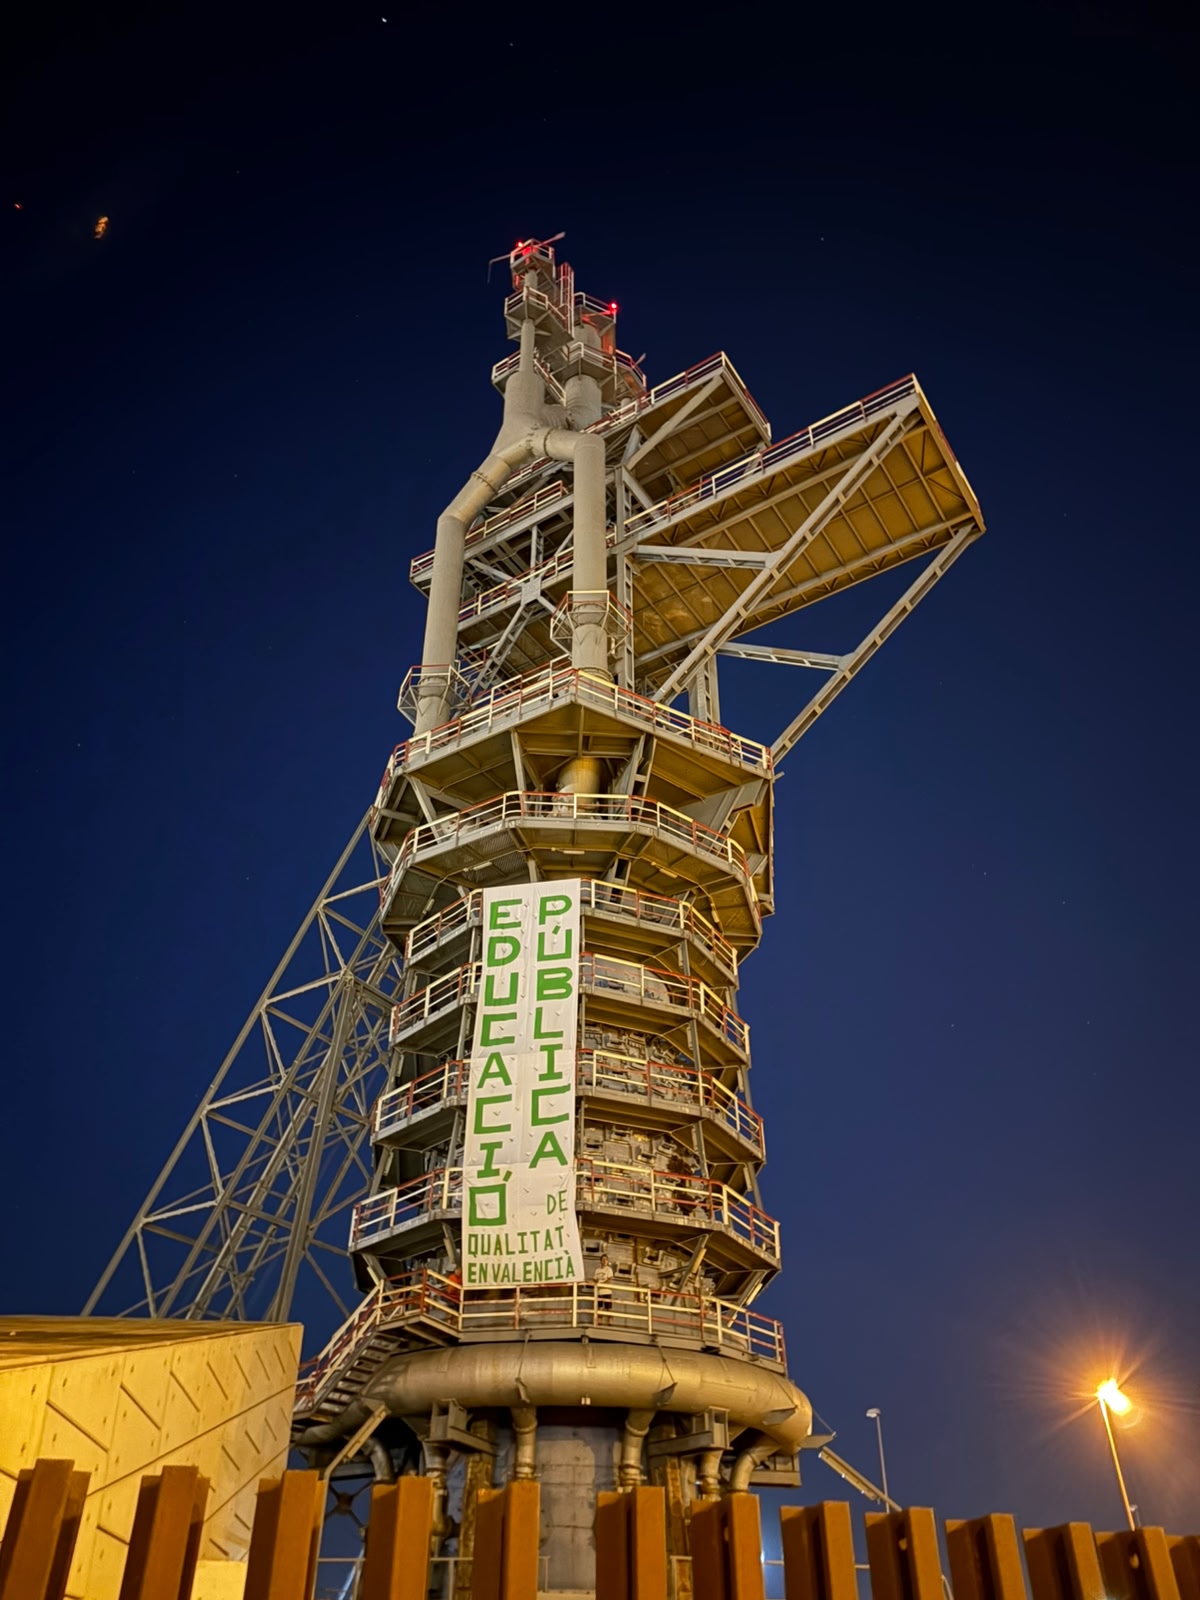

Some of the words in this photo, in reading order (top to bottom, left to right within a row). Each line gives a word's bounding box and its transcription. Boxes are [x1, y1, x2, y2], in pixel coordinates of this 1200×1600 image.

[468, 899, 523, 1226] EDUCACIÓ
[528, 895, 573, 1169] PÚBLICA
[467, 1225, 564, 1258] QUALITAT
[547, 1189, 568, 1215] DE
